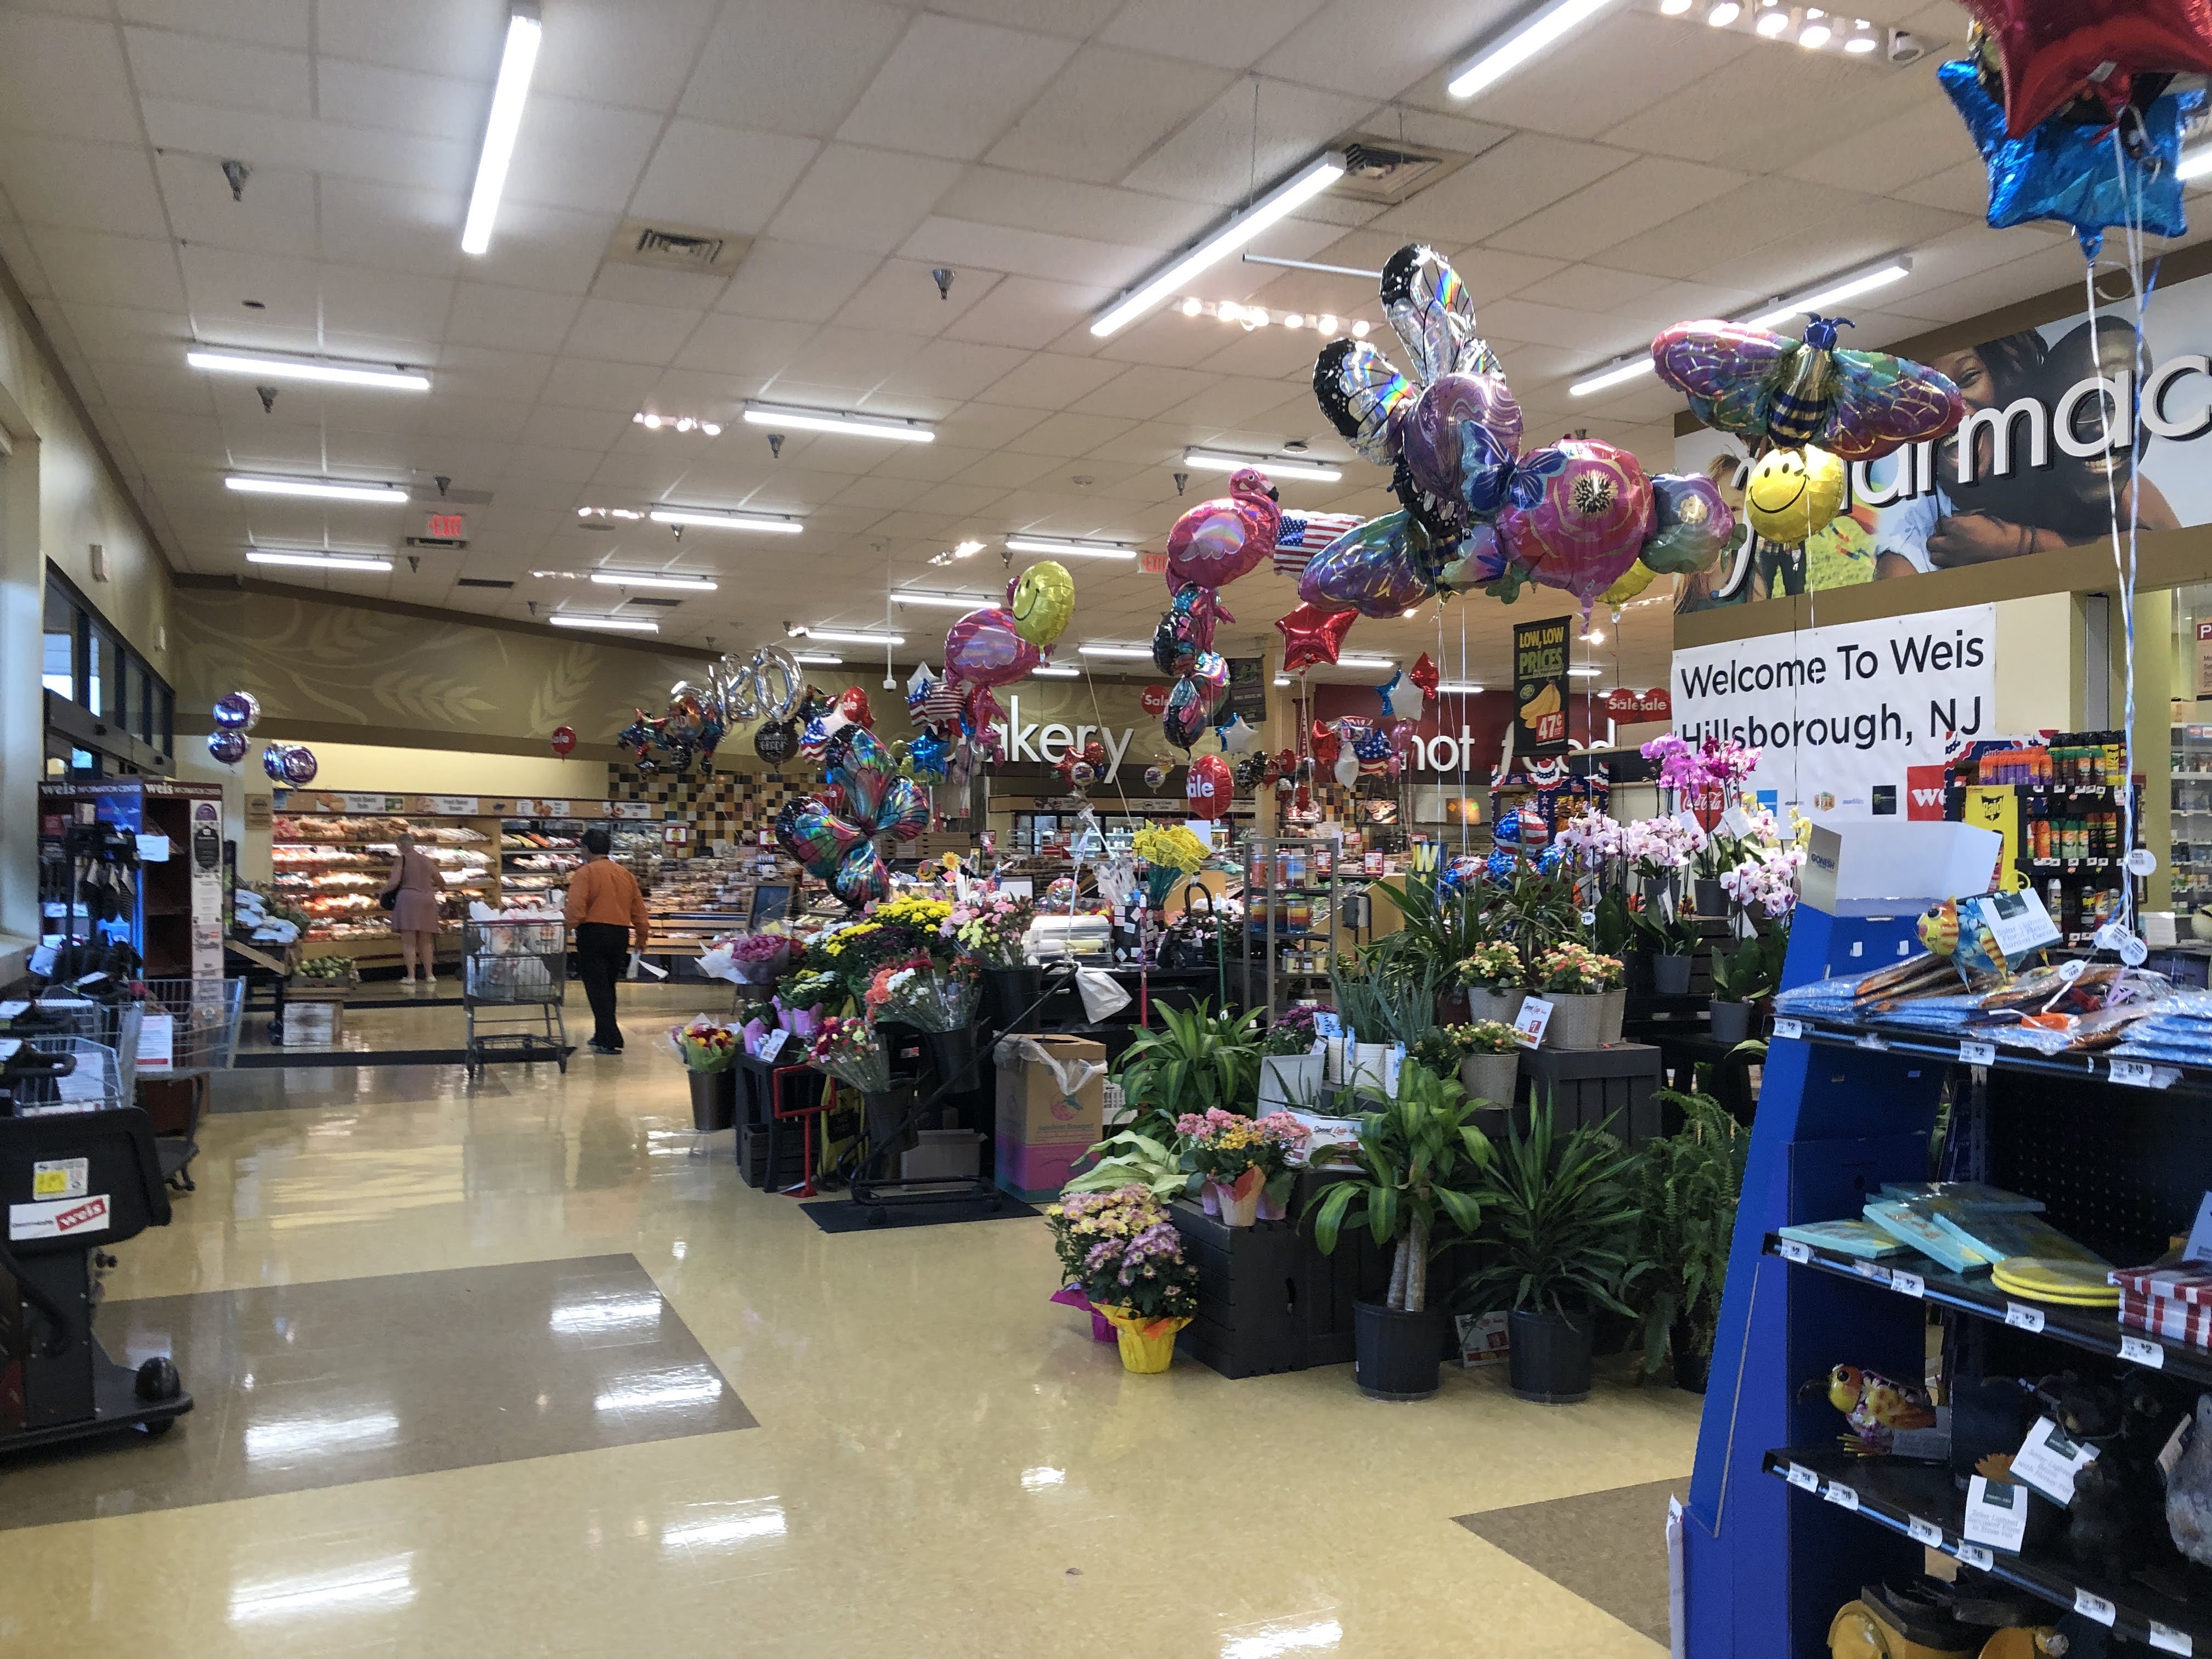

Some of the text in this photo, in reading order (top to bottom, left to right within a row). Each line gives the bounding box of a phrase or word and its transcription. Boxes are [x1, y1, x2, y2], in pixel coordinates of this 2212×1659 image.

[433, 515, 462, 536] EXIT
[1519, 626, 1564, 650] LOW, LOW
[1519, 647, 1563, 674] PRICES
[1681, 629, 1984, 699] Welcome To Weis
[1609, 697, 1638, 710] Sale
[1682, 696, 1981, 752] Hillsborough, NJ
[552, 732, 569, 743] ale
[943, 695, 1135, 784] akery
[1187, 774, 1215, 798] ale
[1983, 798, 2003, 817] Raid
[1811, 854, 1835, 870] GONESH
